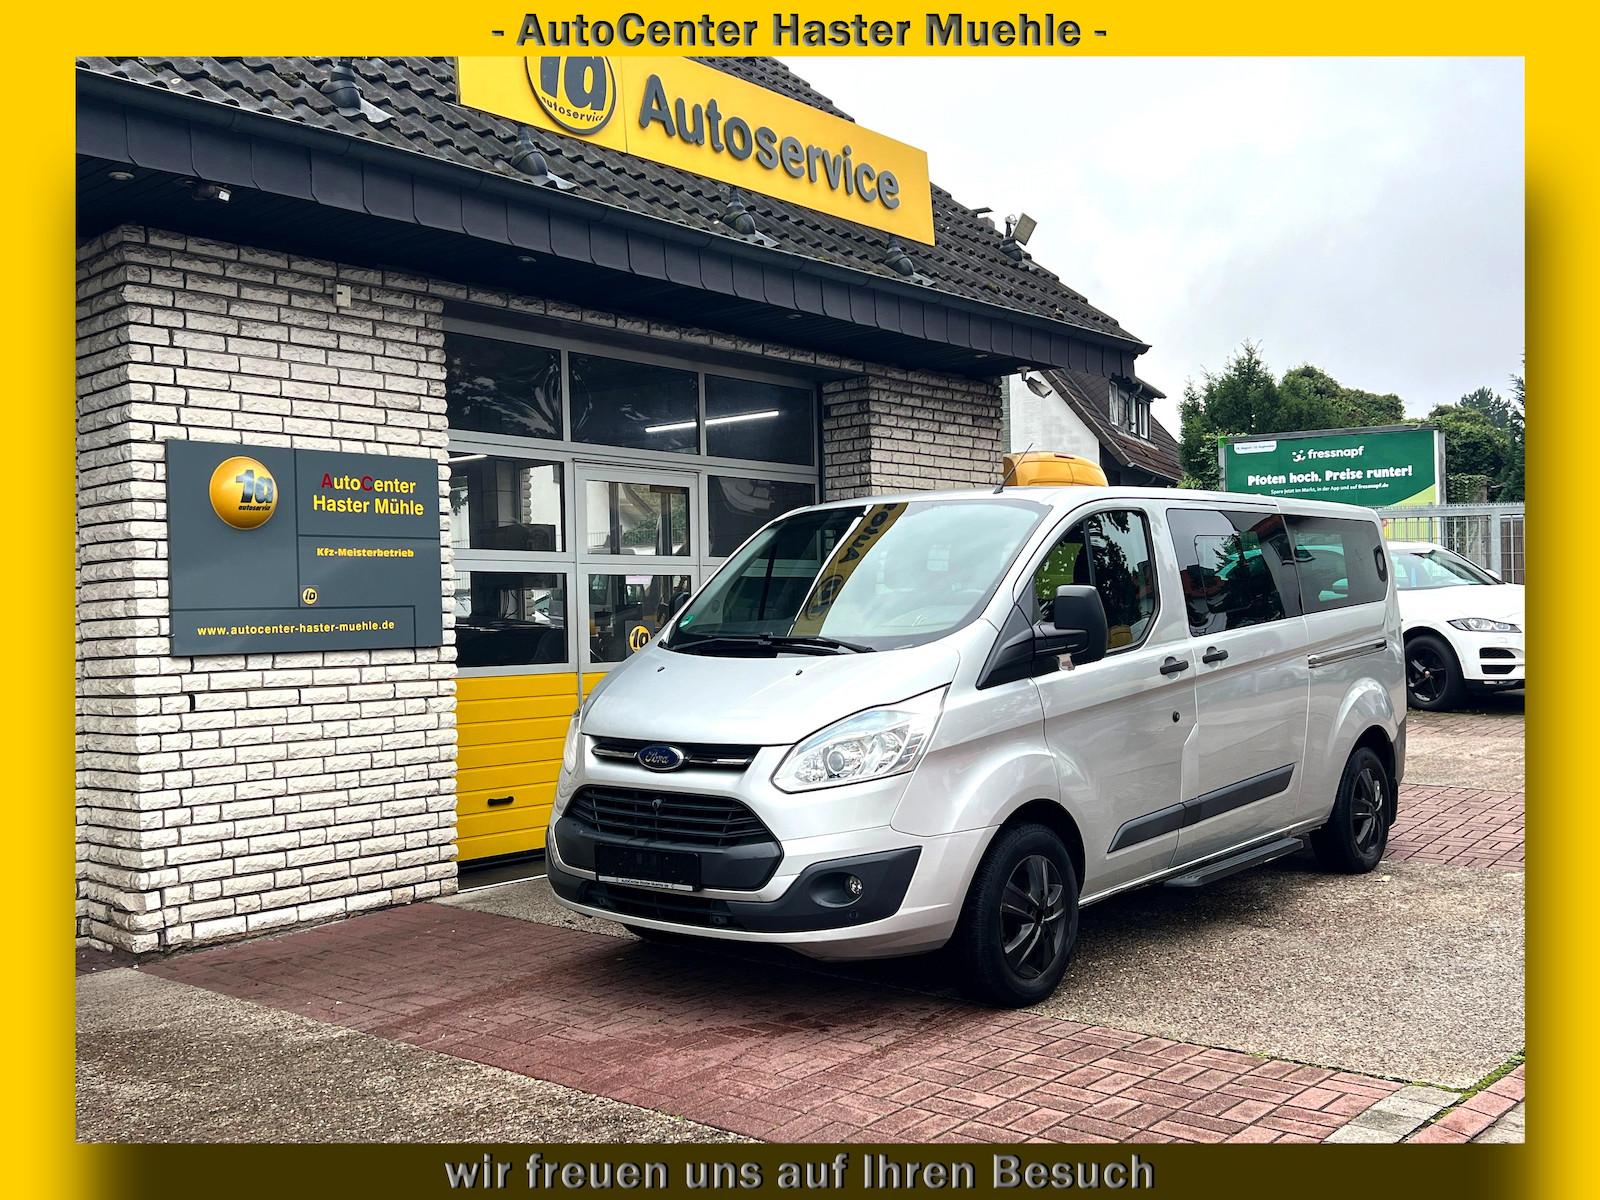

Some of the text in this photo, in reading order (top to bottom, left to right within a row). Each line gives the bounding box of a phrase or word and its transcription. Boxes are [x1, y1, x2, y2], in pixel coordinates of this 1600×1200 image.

[638, 73, 901, 210] Autoservice
[1307, 445, 1365, 459] fressnapf
[236, 469, 273, 503] 1a
[321, 473, 417, 494] AutoCenter
[1247, 474, 1287, 487] Pfoten
[1325, 468, 1363, 481] Preise
[1366, 464, 1413, 479] runter!
[313, 495, 424, 516] Haster Mühle
[316, 547, 415, 559] Kfz-Meisterbetrieb
[197, 620, 396, 636] www.autocenter-haster-muehle.de
